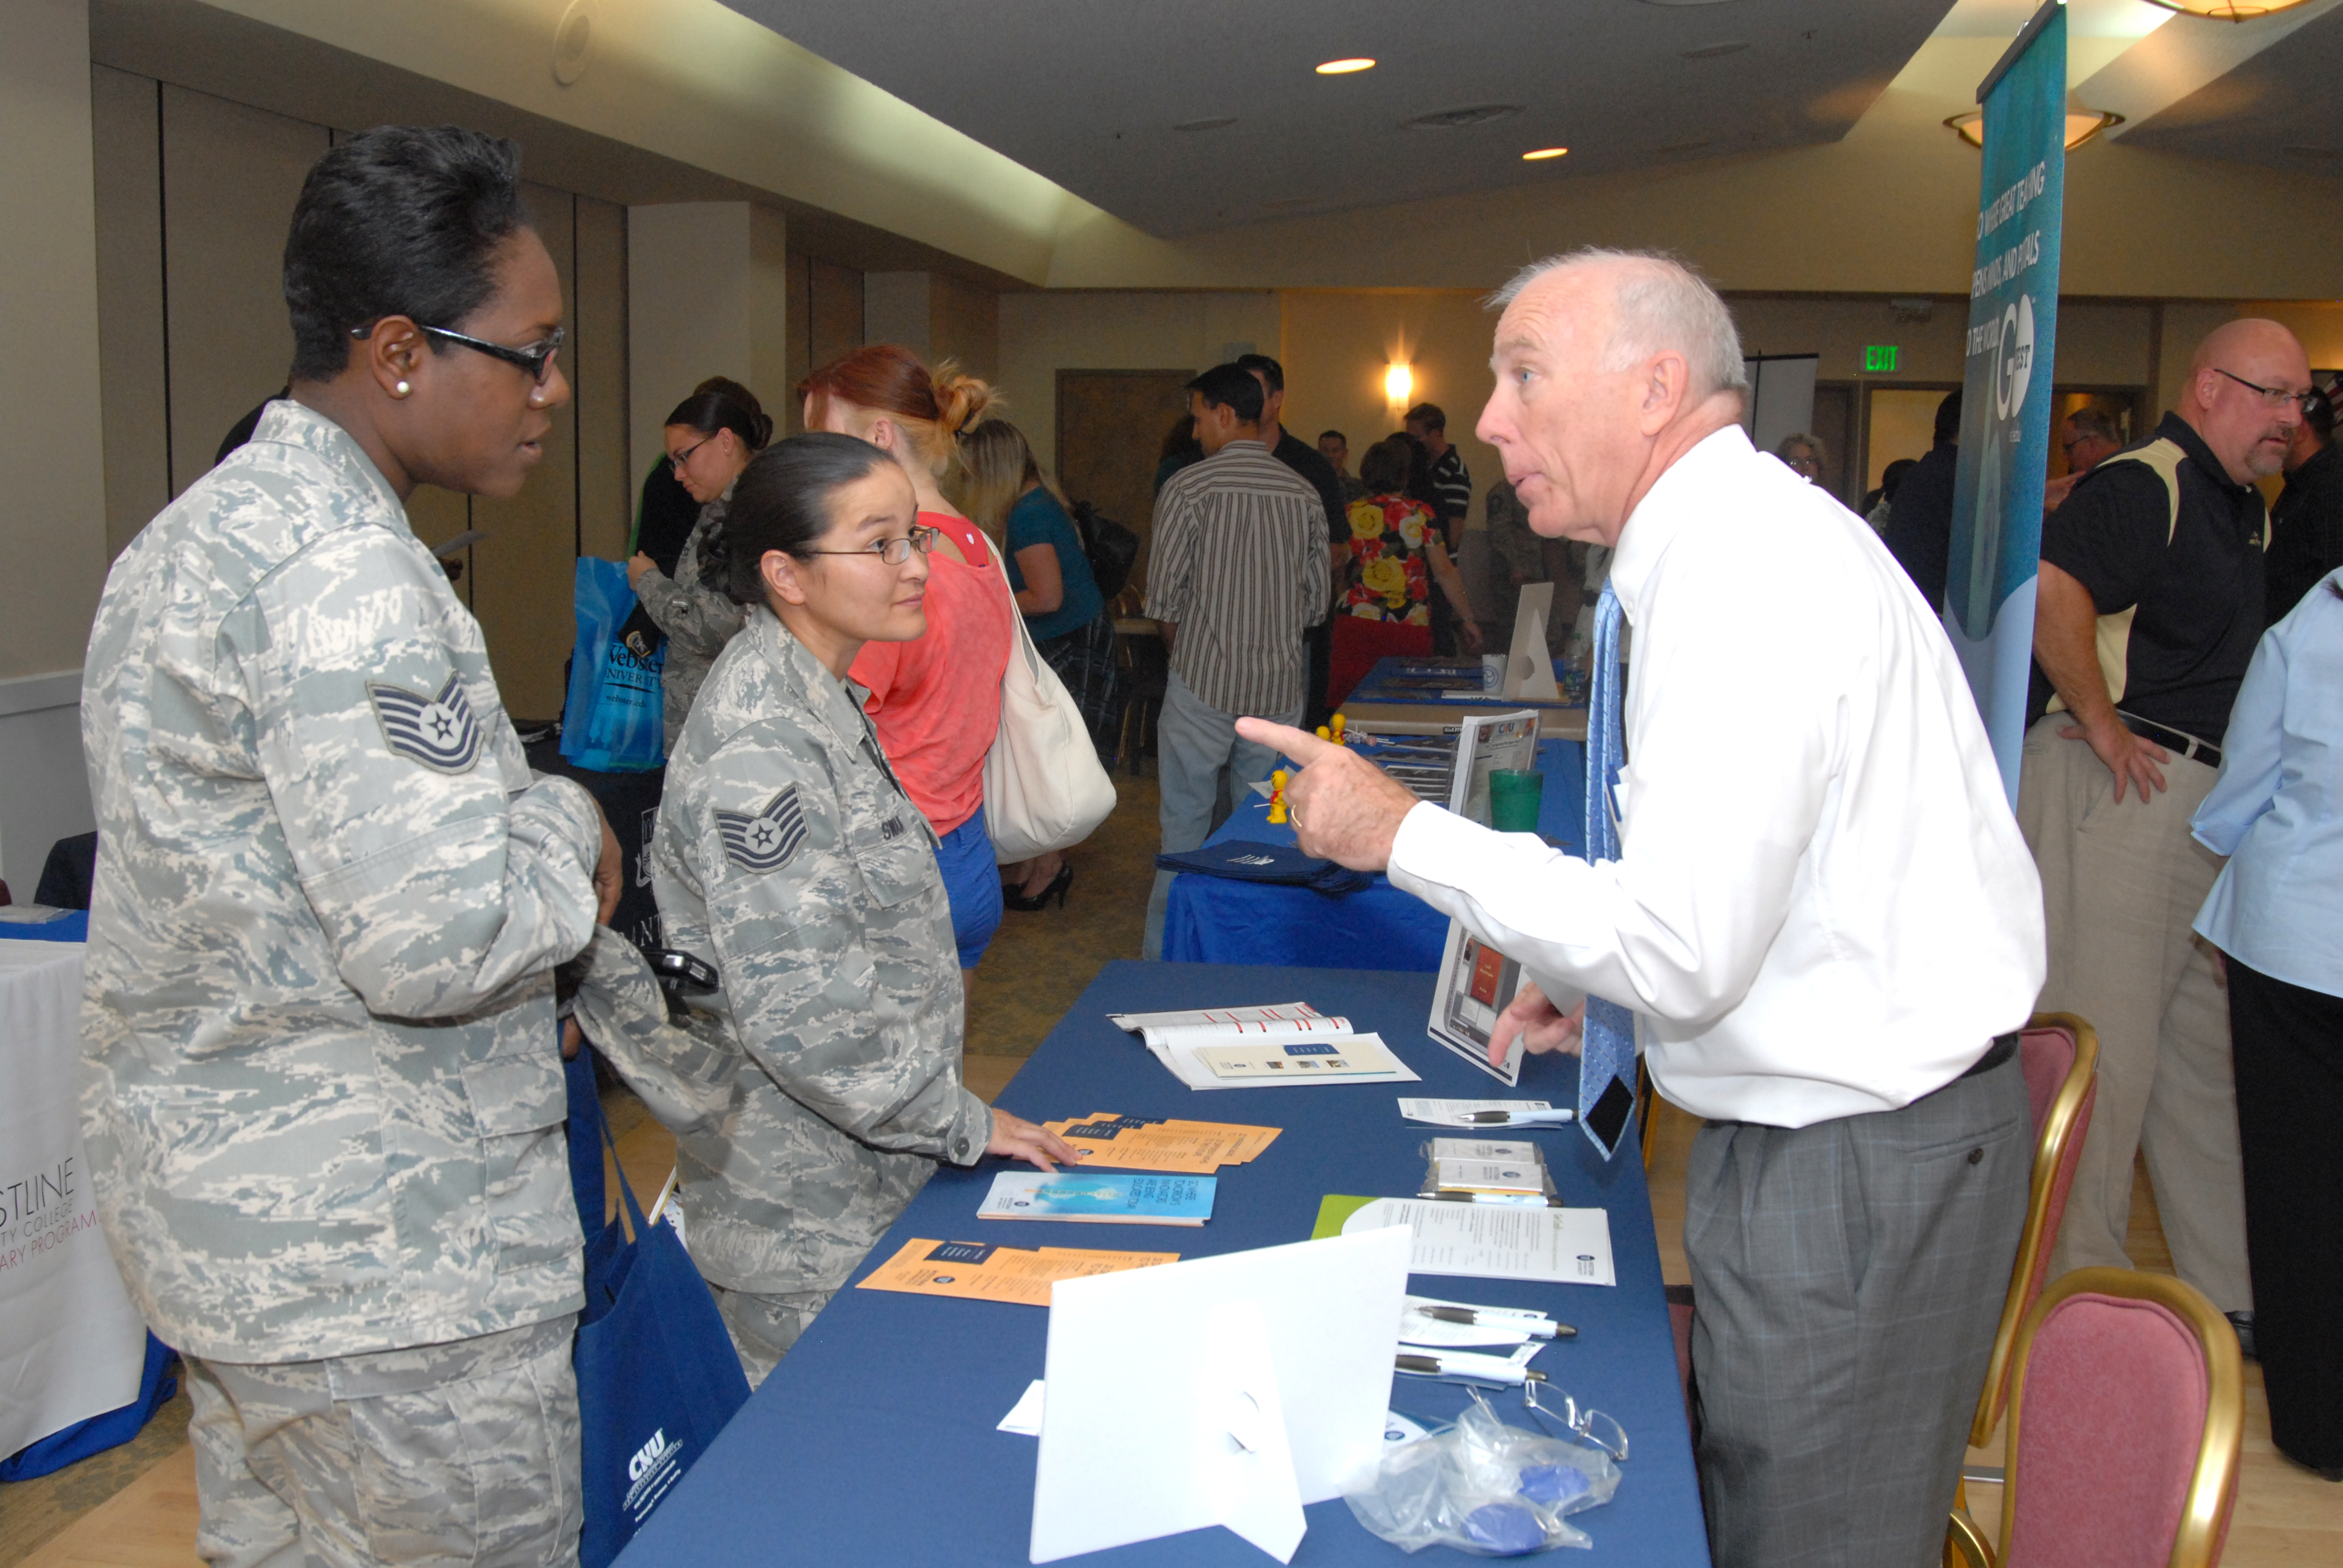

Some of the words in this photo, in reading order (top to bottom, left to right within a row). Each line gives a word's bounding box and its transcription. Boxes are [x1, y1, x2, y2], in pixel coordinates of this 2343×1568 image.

[1999, 184, 2017, 224] GREAT
[2017, 160, 2045, 212] TEANG
[1971, 266, 1988, 298] PENS
[2002, 247, 2017, 282] AND
[2017, 230, 2040, 275] PALS
[1866, 345, 1898, 370] EXIT
[1972, 325, 1984, 356] THE
[609, 644, 664, 675] Webser
[605, 667, 661, 689] NIVERITY
[24, 1198, 73, 1237] COLLEGE
[31, 1210, 99, 1258] PROGRAM
